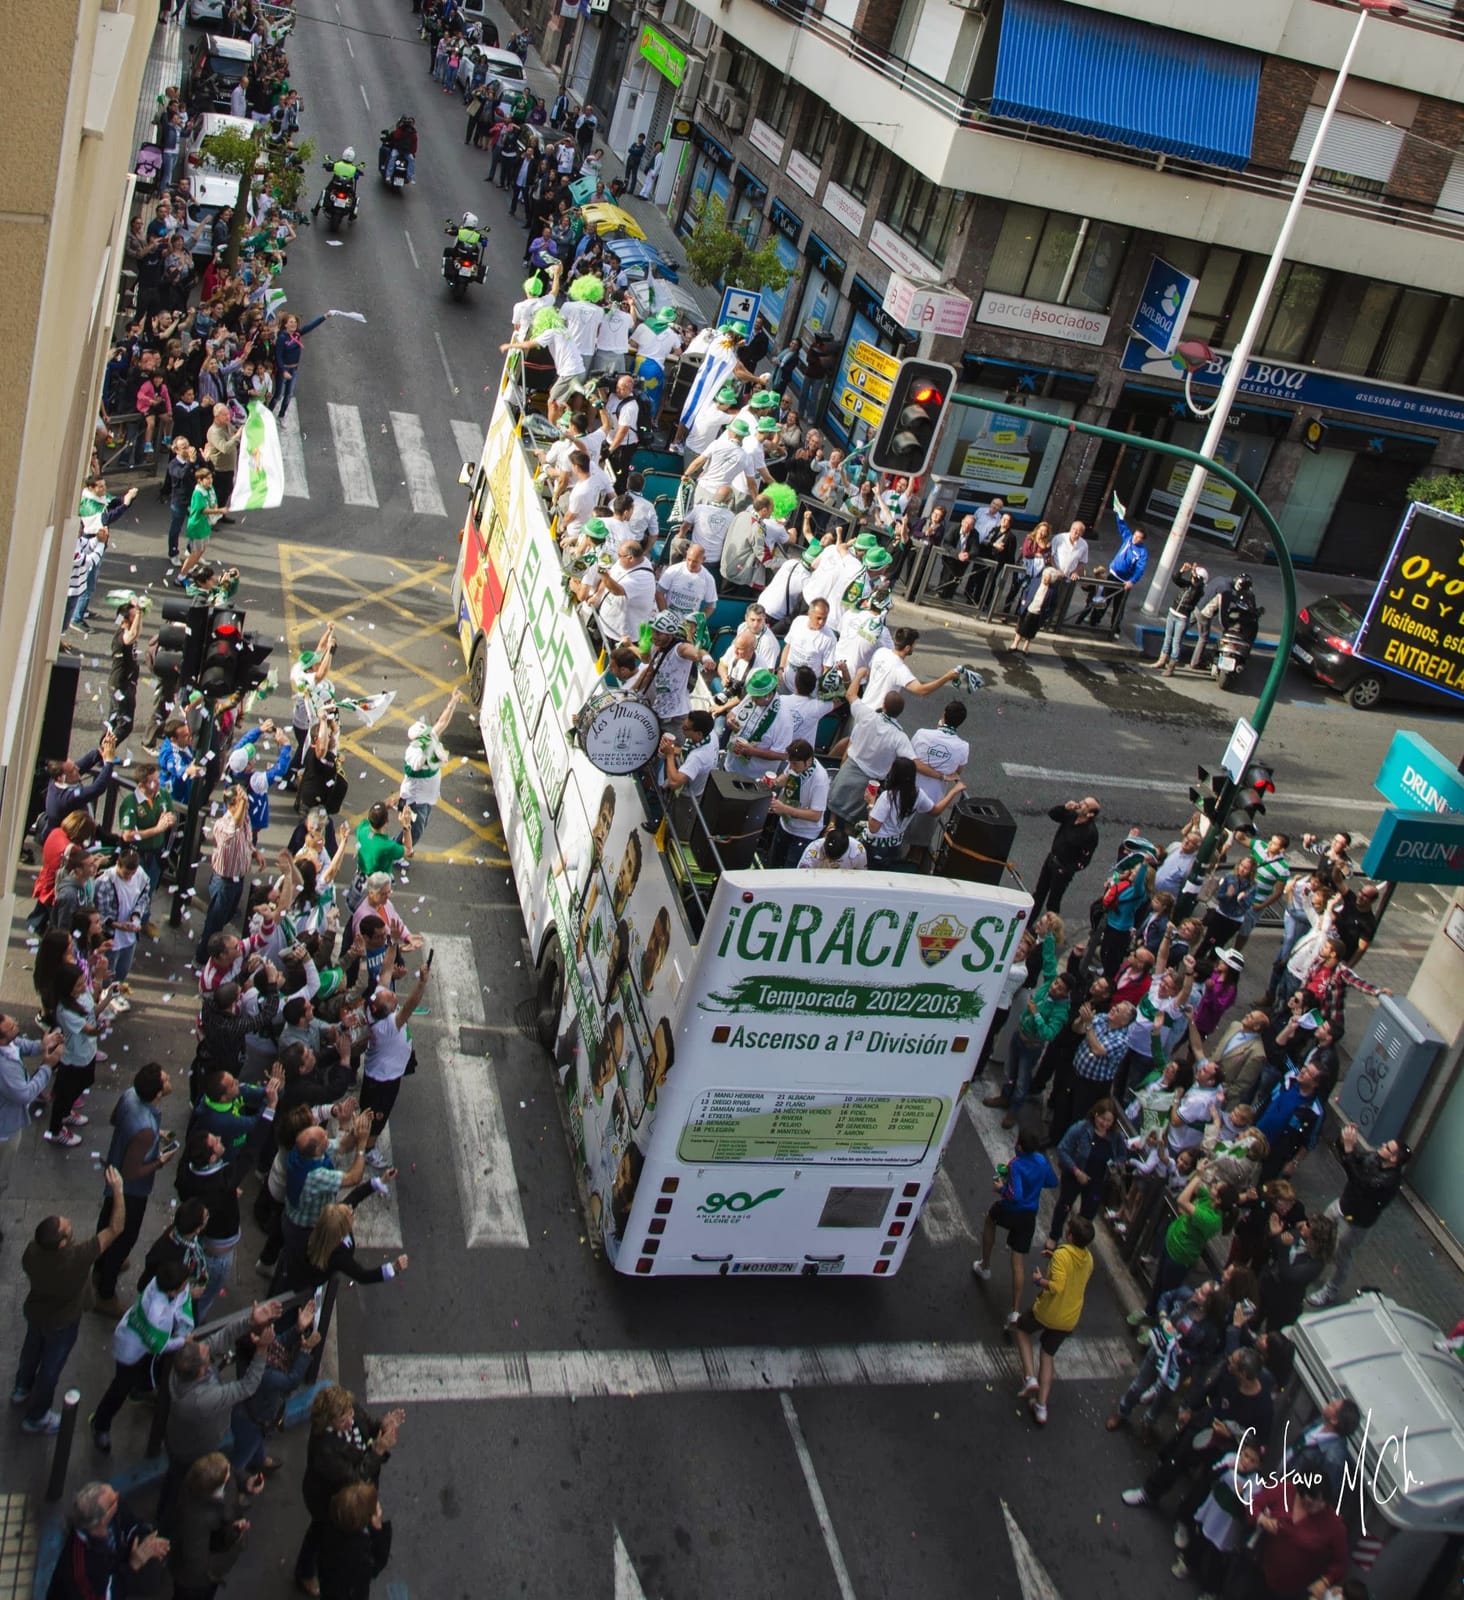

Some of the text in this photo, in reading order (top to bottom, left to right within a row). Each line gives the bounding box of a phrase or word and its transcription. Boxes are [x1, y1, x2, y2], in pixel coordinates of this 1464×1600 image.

[520, 538, 574, 710] ELCHE
[1381, 604, 1439, 648] Visítenos,
[592, 704, 656, 740] Los Murcianos
[930, 748, 948, 759] ECF
[1396, 840, 1457, 862] DRUNI
[758, 984, 962, 1015] Temporada 2012/2013
[730, 1025, 948, 1056] Ascenso a 1ª División
